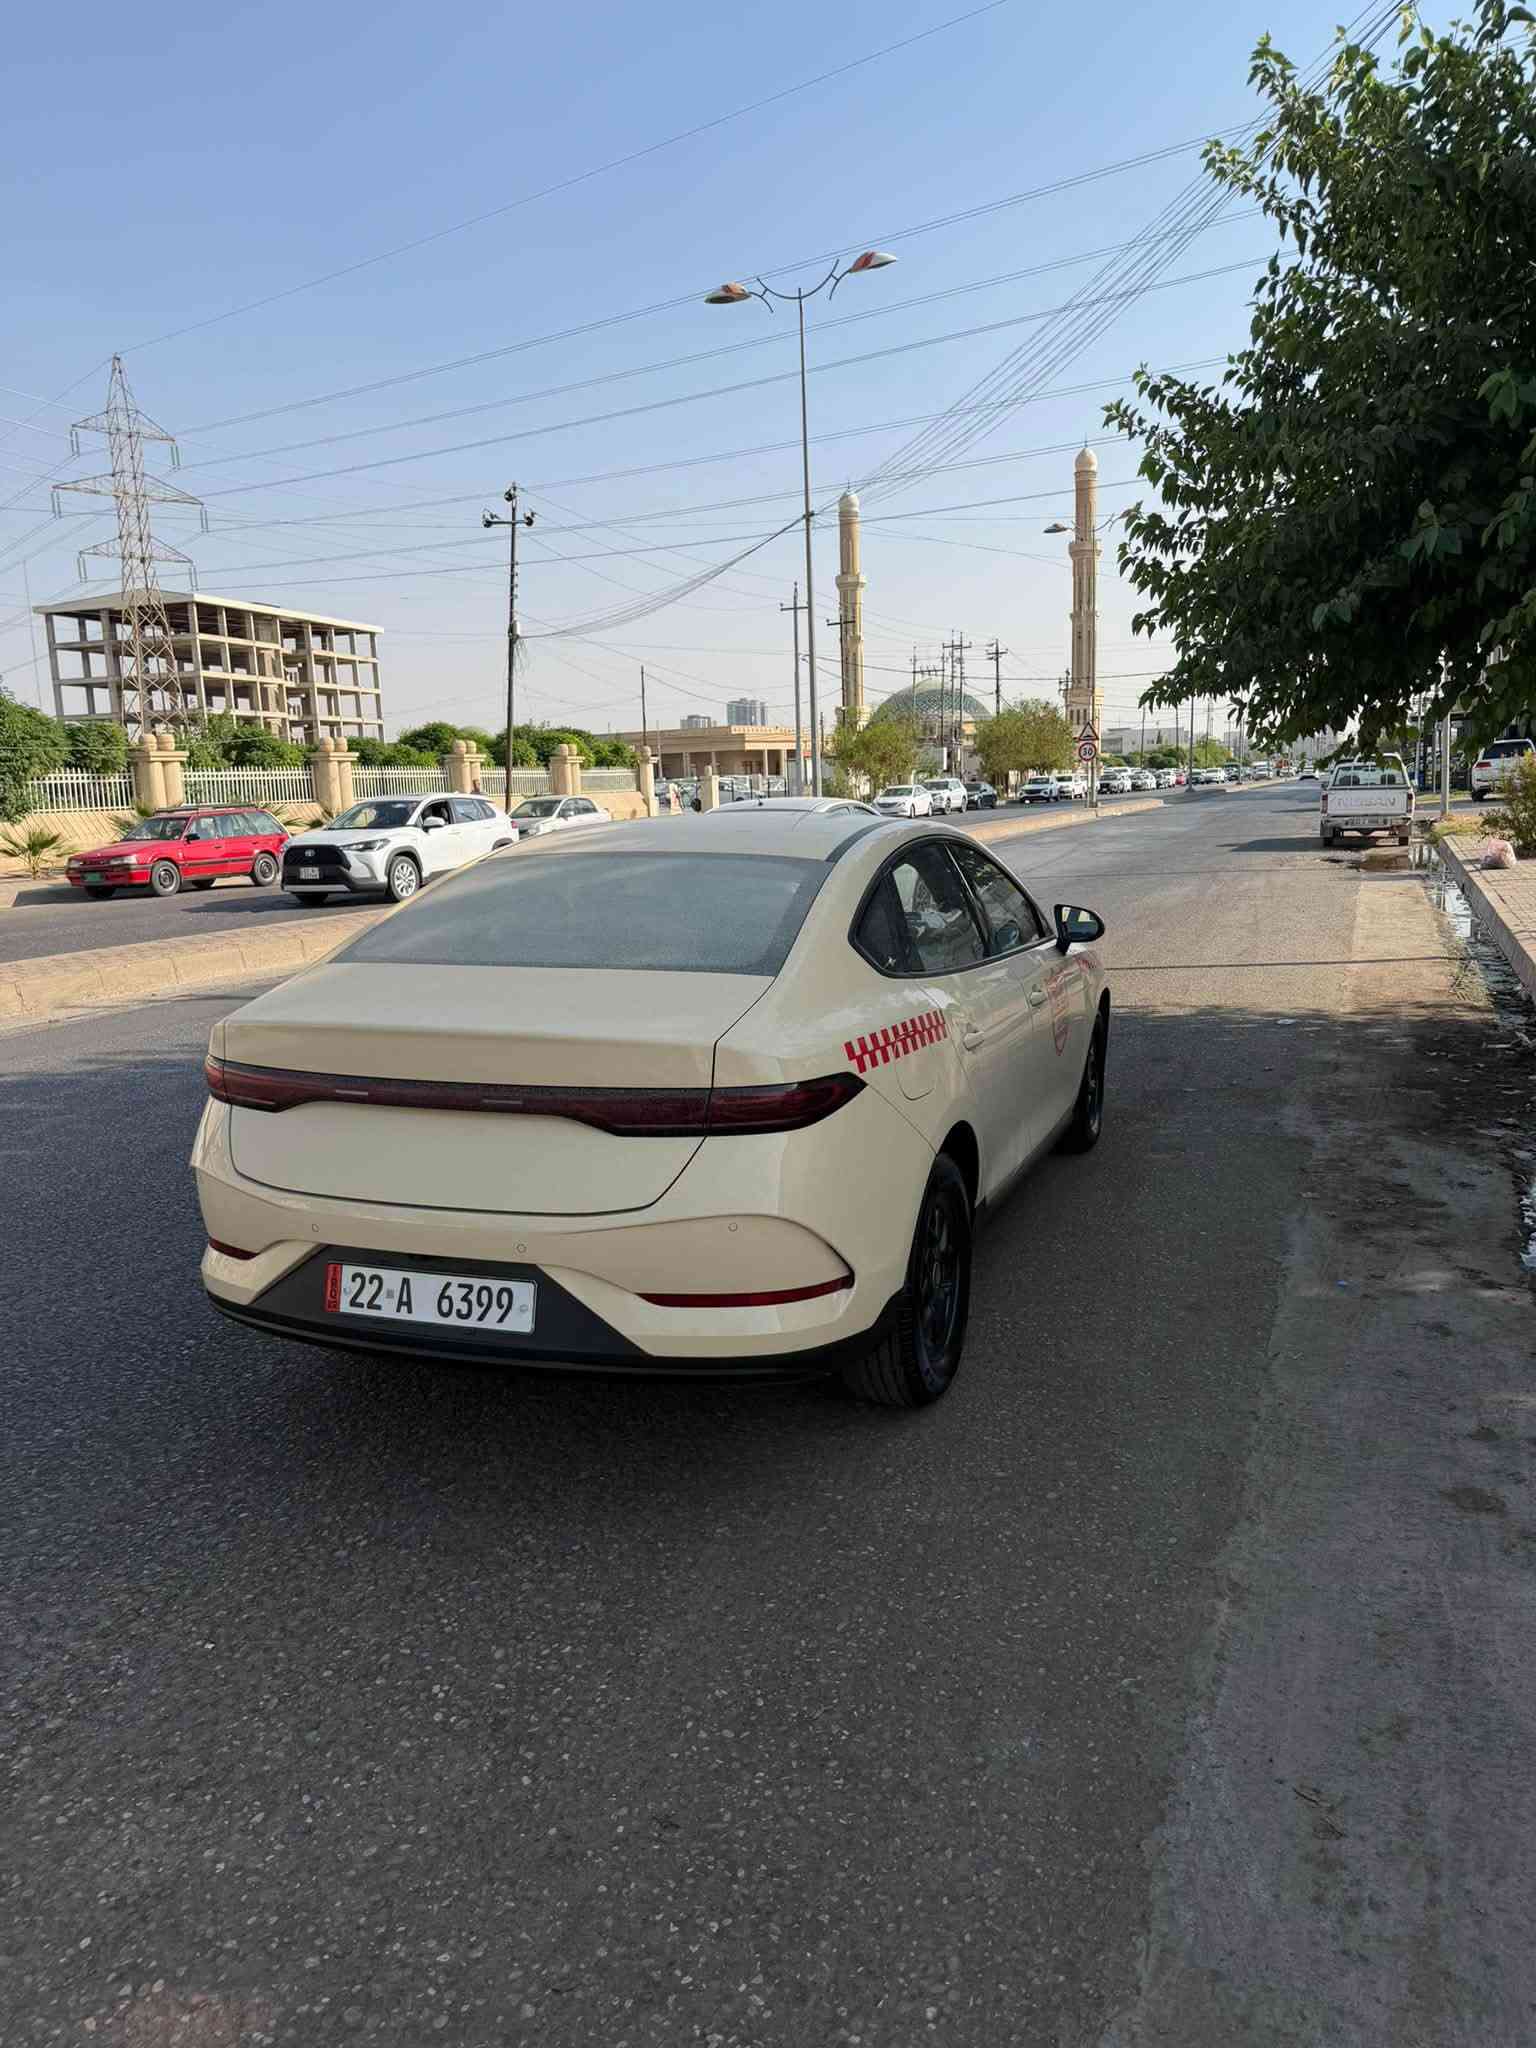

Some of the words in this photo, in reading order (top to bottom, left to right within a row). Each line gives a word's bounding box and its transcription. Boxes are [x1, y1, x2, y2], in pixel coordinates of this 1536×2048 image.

[350, 1272, 384, 1310] 22
[396, 1277, 413, 1314] A
[437, 1282, 514, 1324] 6399
